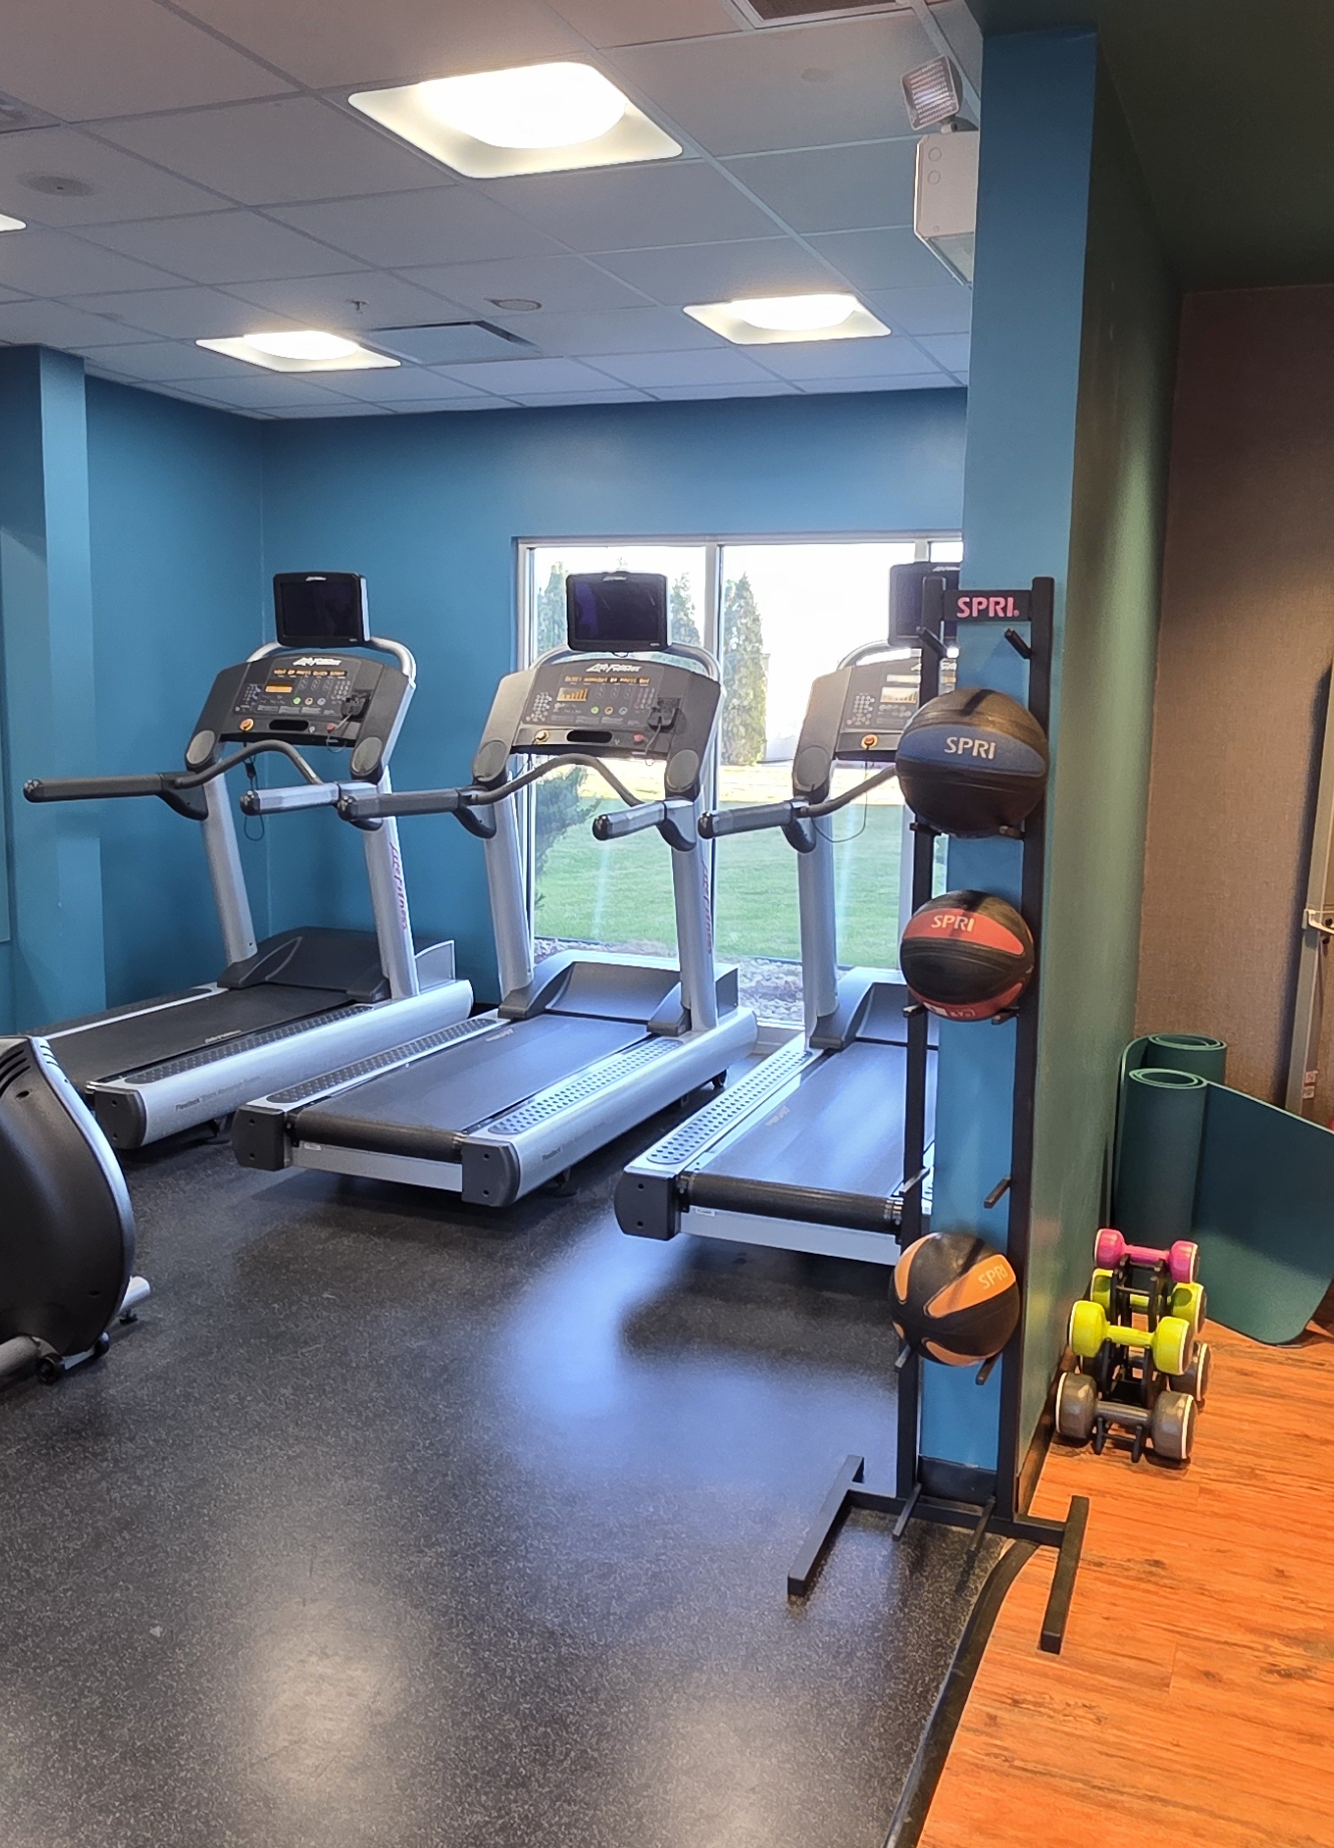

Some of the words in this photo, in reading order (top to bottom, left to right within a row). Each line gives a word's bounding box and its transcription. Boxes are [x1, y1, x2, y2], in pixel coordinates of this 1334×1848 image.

[944, 736, 996, 760] SPRI
[931, 915, 975, 932] SPRI
[978, 1264, 1009, 1290] SPRI
